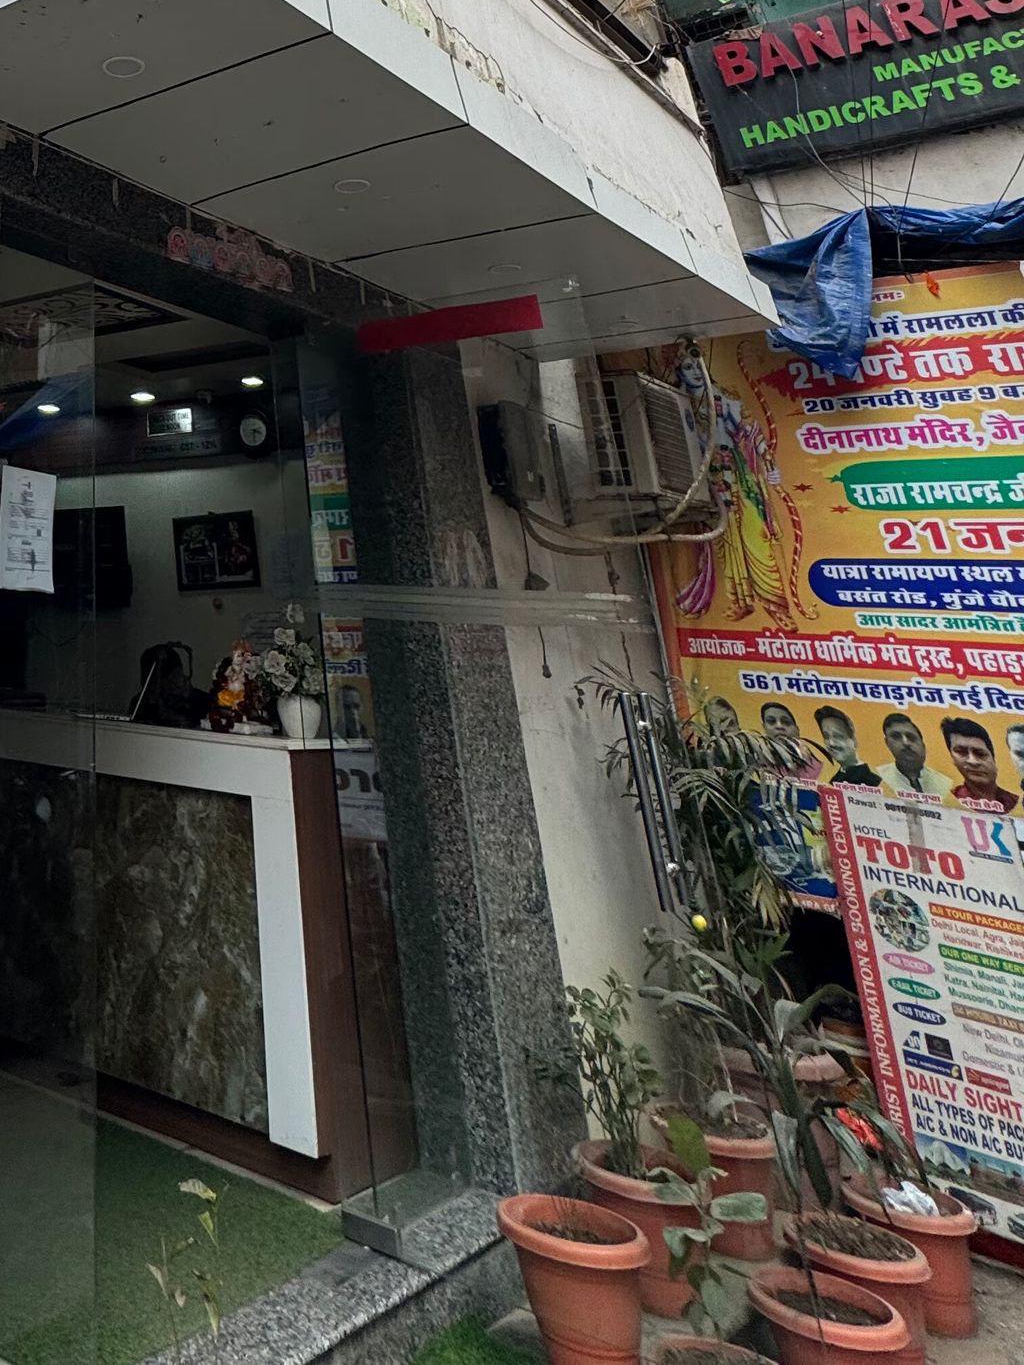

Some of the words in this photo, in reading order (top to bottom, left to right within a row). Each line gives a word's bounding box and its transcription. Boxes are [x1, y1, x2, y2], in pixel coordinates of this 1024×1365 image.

[873, 30, 1024, 82] MANUFAC
[739, 72, 983, 149] HANDICRAFTS
[990, 65, 1021, 89] &
[881, 316, 900, 335] में
[904, 310, 998, 333] रामलला
[909, 347, 974, 378] तक
[805, 399, 835, 413] 20
[837, 390, 915, 409] जनवरी
[917, 389, 973, 408] सुबह
[978, 386, 997, 400] 9
[800, 427, 904, 450] दीनानाथ
[850, 483, 907, 505] राजा
[908, 481, 1004, 504] रामचन्द्र
[883, 521, 947, 550] 21
[821, 564, 869, 580] यात्रा
[871, 565, 958, 582] रामायण
[959, 566, 1014, 583] स्थल
[858, 613, 893, 627] आप
[896, 615, 939, 629] सादर
[814, 635, 877, 664] धार्मिक
[877, 637, 913, 667] मंच
[742, 673, 782, 692] 561
[785, 672, 849, 697] मंटोला
[946, 685, 982, 710] नई
[825, 793, 849, 855] CENTRE
[853, 824, 891, 840] HOTEL
[856, 835, 965, 881] TOTO
[839, 858, 865, 935] BOOKING
[863, 864, 1024, 913] INTERNATIONAL
[945, 908, 974, 923] TOUR
[859, 956, 893, 1078] INFORMATION
[896, 1004, 913, 1015] BUS
[914, 1008, 941, 1023] TICKET
[905, 1068, 957, 1102] DAILY
[912, 1093, 935, 1114] ALL
[935, 1100, 976, 1127] TYPES
[977, 1113, 995, 1132] OF
[938, 1120, 948, 1136] &
[949, 1123, 979, 1147] NON
